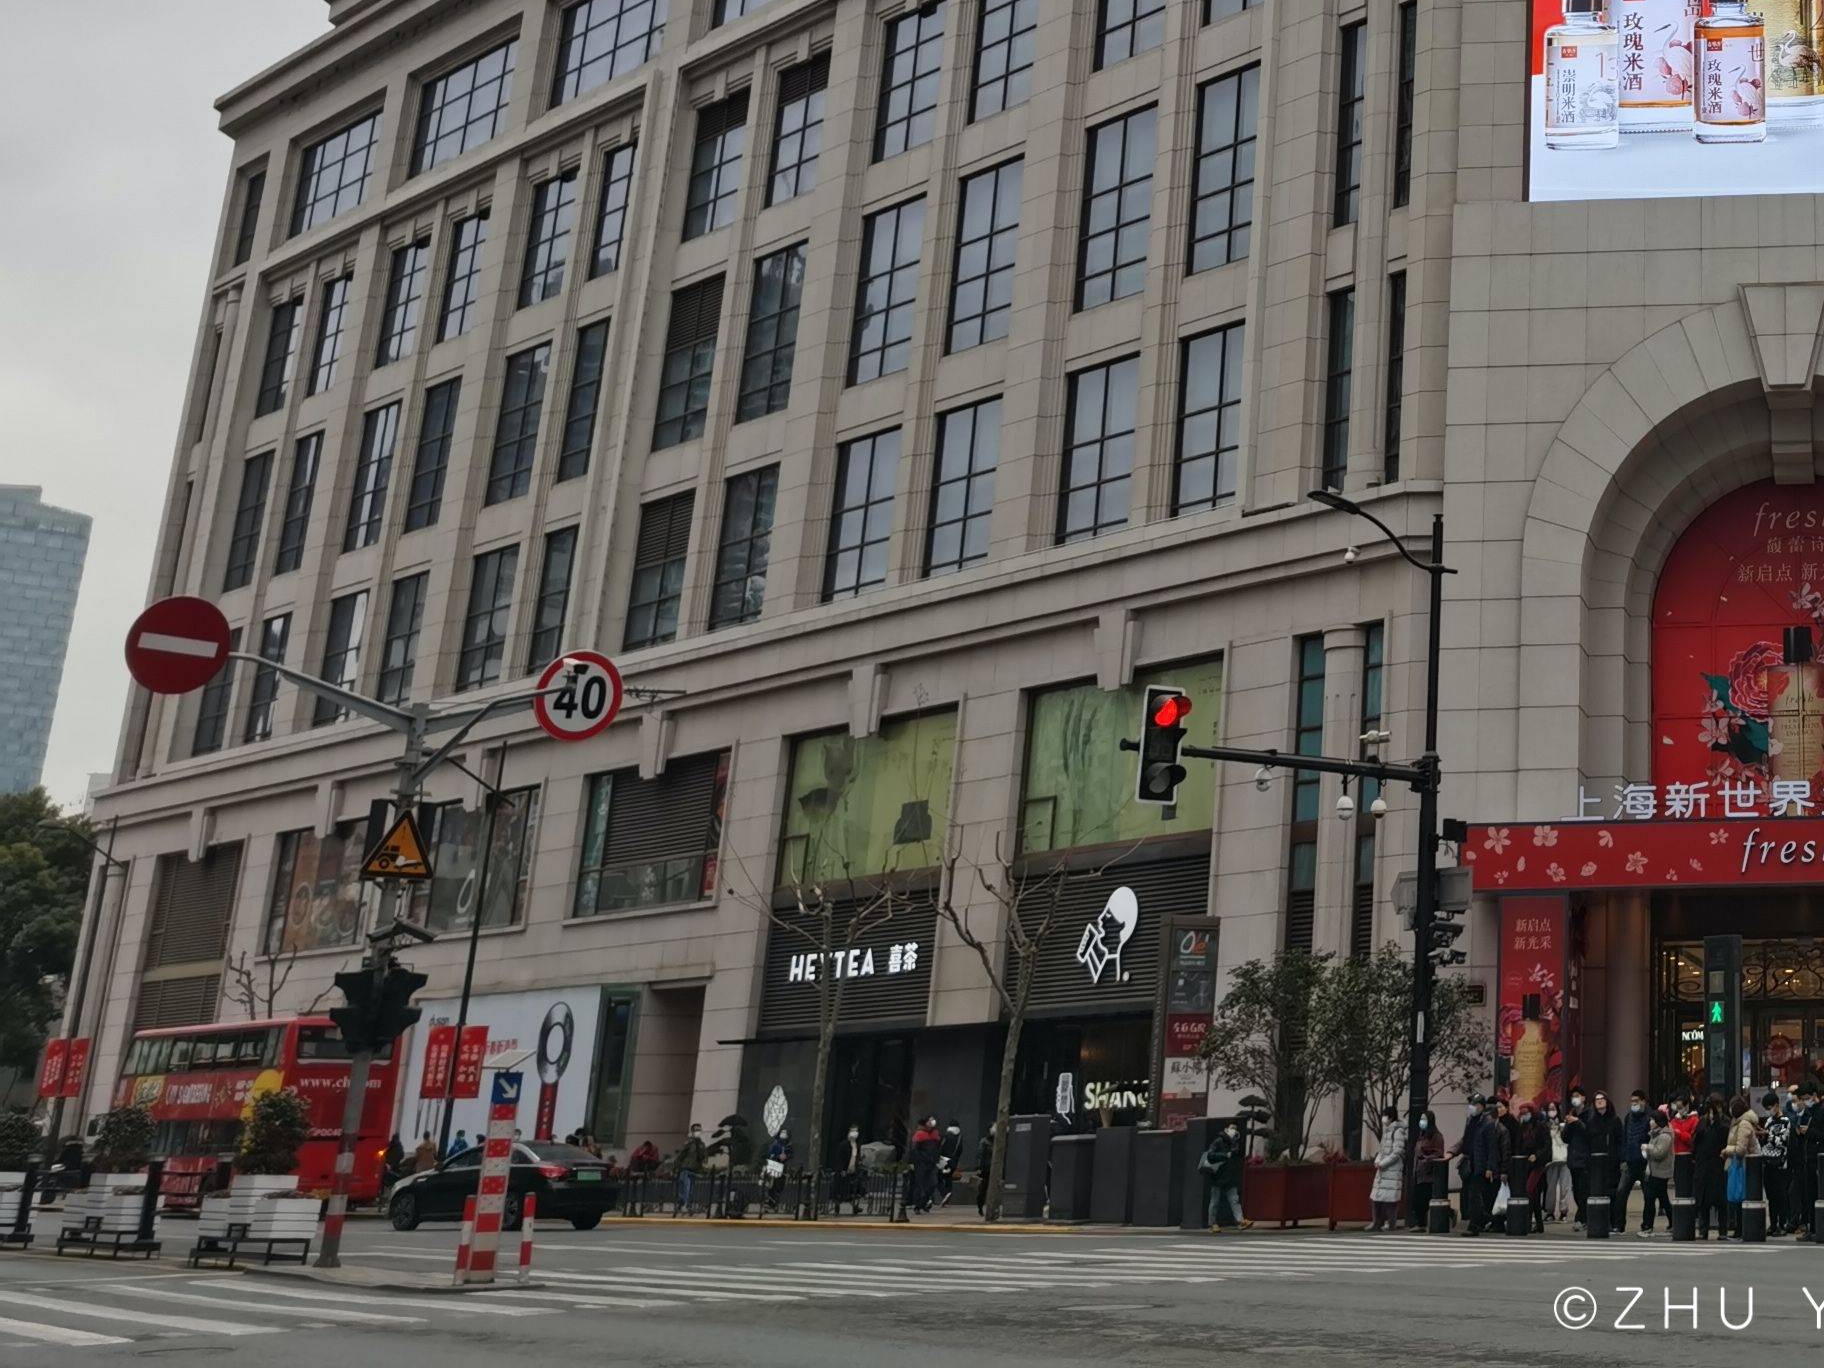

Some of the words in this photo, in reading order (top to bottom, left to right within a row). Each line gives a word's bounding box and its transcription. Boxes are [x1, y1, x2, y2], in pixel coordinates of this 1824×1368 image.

[1621, 11, 1645, 92] 玫瑰米酒
[1561, 68, 1577, 124] 崇明米酒
[1707, 58, 1723, 114] 玫瑰米酒
[1737, 563, 1793, 583] 新启点
[552, 675, 607, 720] 40
[1512, 935, 1553, 951] 新光采
[1514, 917, 1552, 933] 新启点
[888, 941, 919, 974] 喜茶
